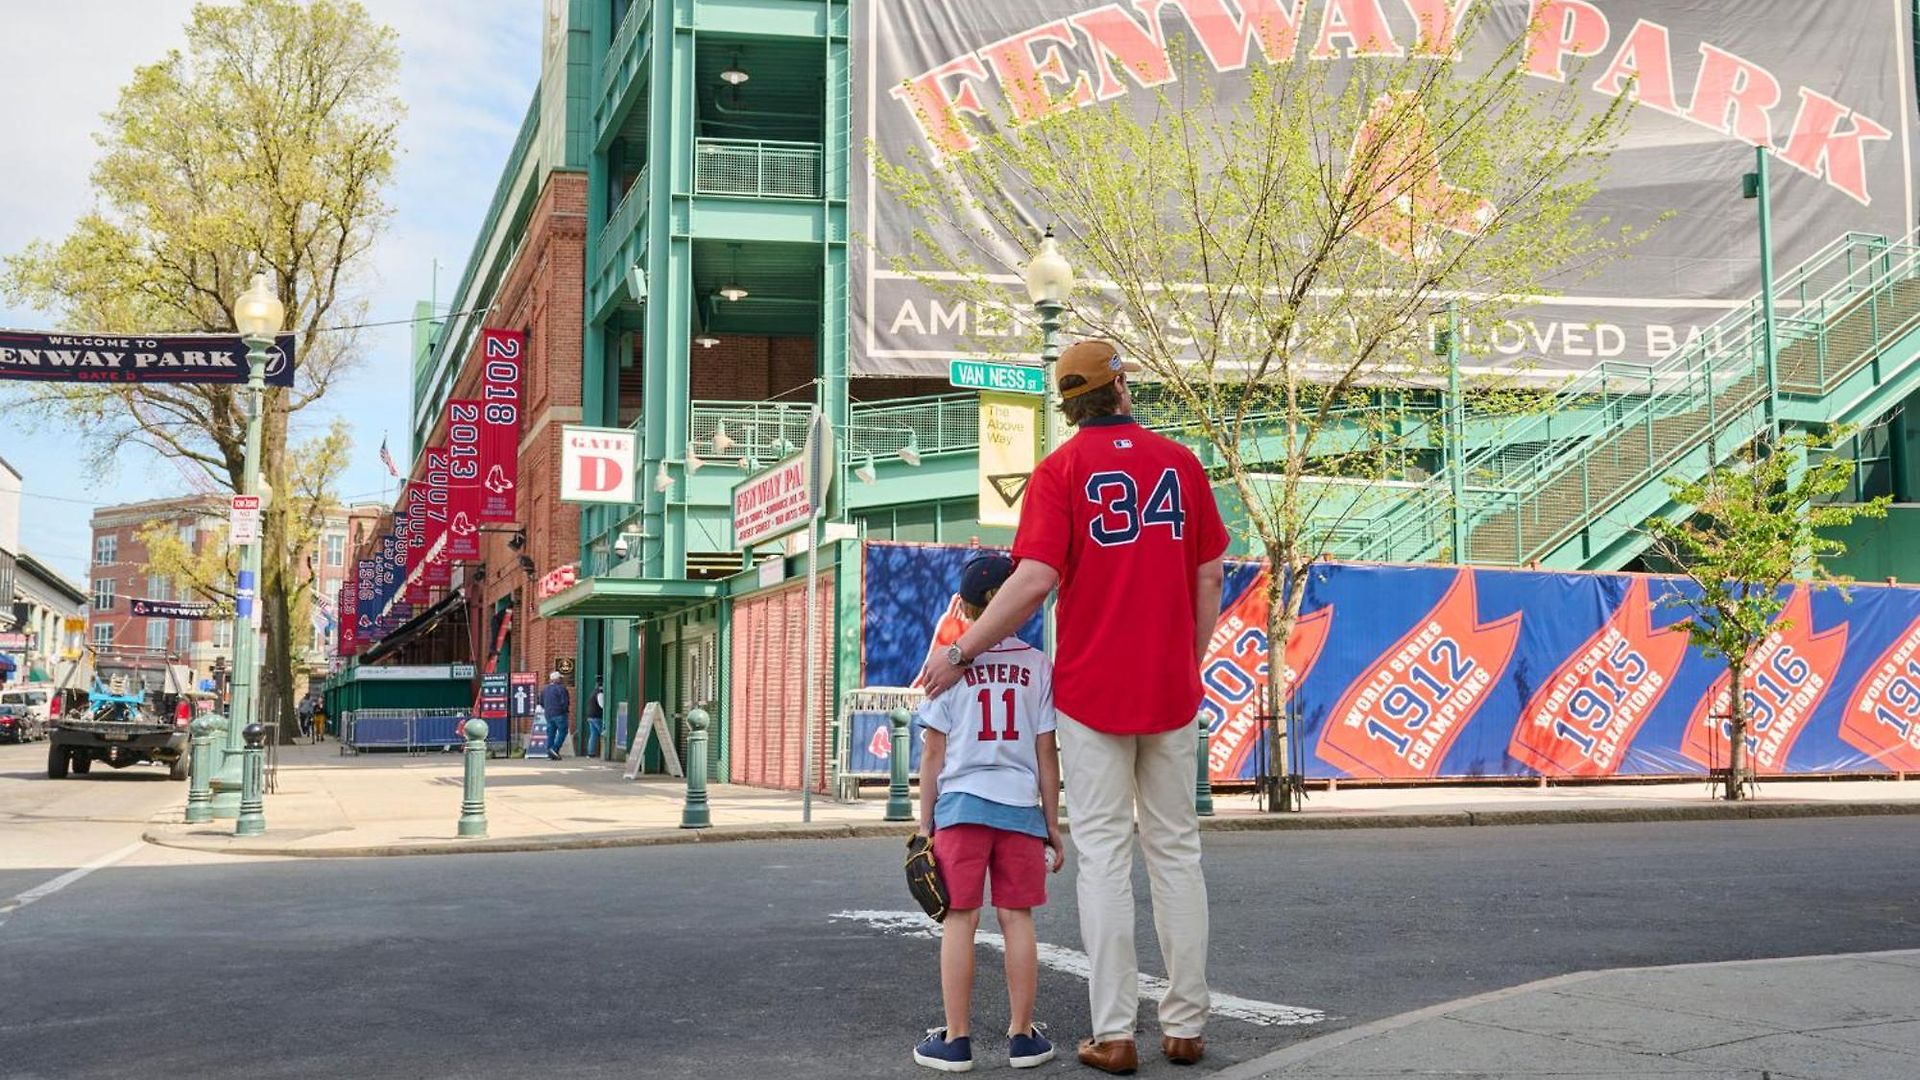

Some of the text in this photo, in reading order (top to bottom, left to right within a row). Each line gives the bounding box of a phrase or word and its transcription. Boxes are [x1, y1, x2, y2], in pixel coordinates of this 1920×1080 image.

[890, 0, 1892, 206] FENWAY PARK
[0, 347, 238, 368] ENWAY PARK
[48, 336, 158, 349] WELCOME TO
[78, 371, 137, 381] GATE D
[958, 364, 984, 386] VAN
[989, 366, 1026, 389] NESS
[485, 337, 519, 425] 2018
[451, 404, 478, 478] 2013
[571, 437, 629, 451] GATE
[576, 455, 623, 492] D
[428, 453, 448, 523] 2007
[736, 472, 782, 515] FENWAY
[1085, 467, 1187, 547] 34
[963, 663, 1031, 688] DEVERS
[1344, 620, 1443, 729] WORLD SERIES
[1365, 636, 1476, 758] 1912
[1534, 626, 1621, 729] WORLD SERIES
[1553, 639, 1648, 758] 1915
[1859, 662, 1898, 714] WORLD
[977, 688, 1020, 742] 11
[1407, 666, 1491, 771] CHAMPIONS
[1593, 670, 1664, 770] CHAMPIONS
[1757, 672, 1825, 768] CHAMPIONS
